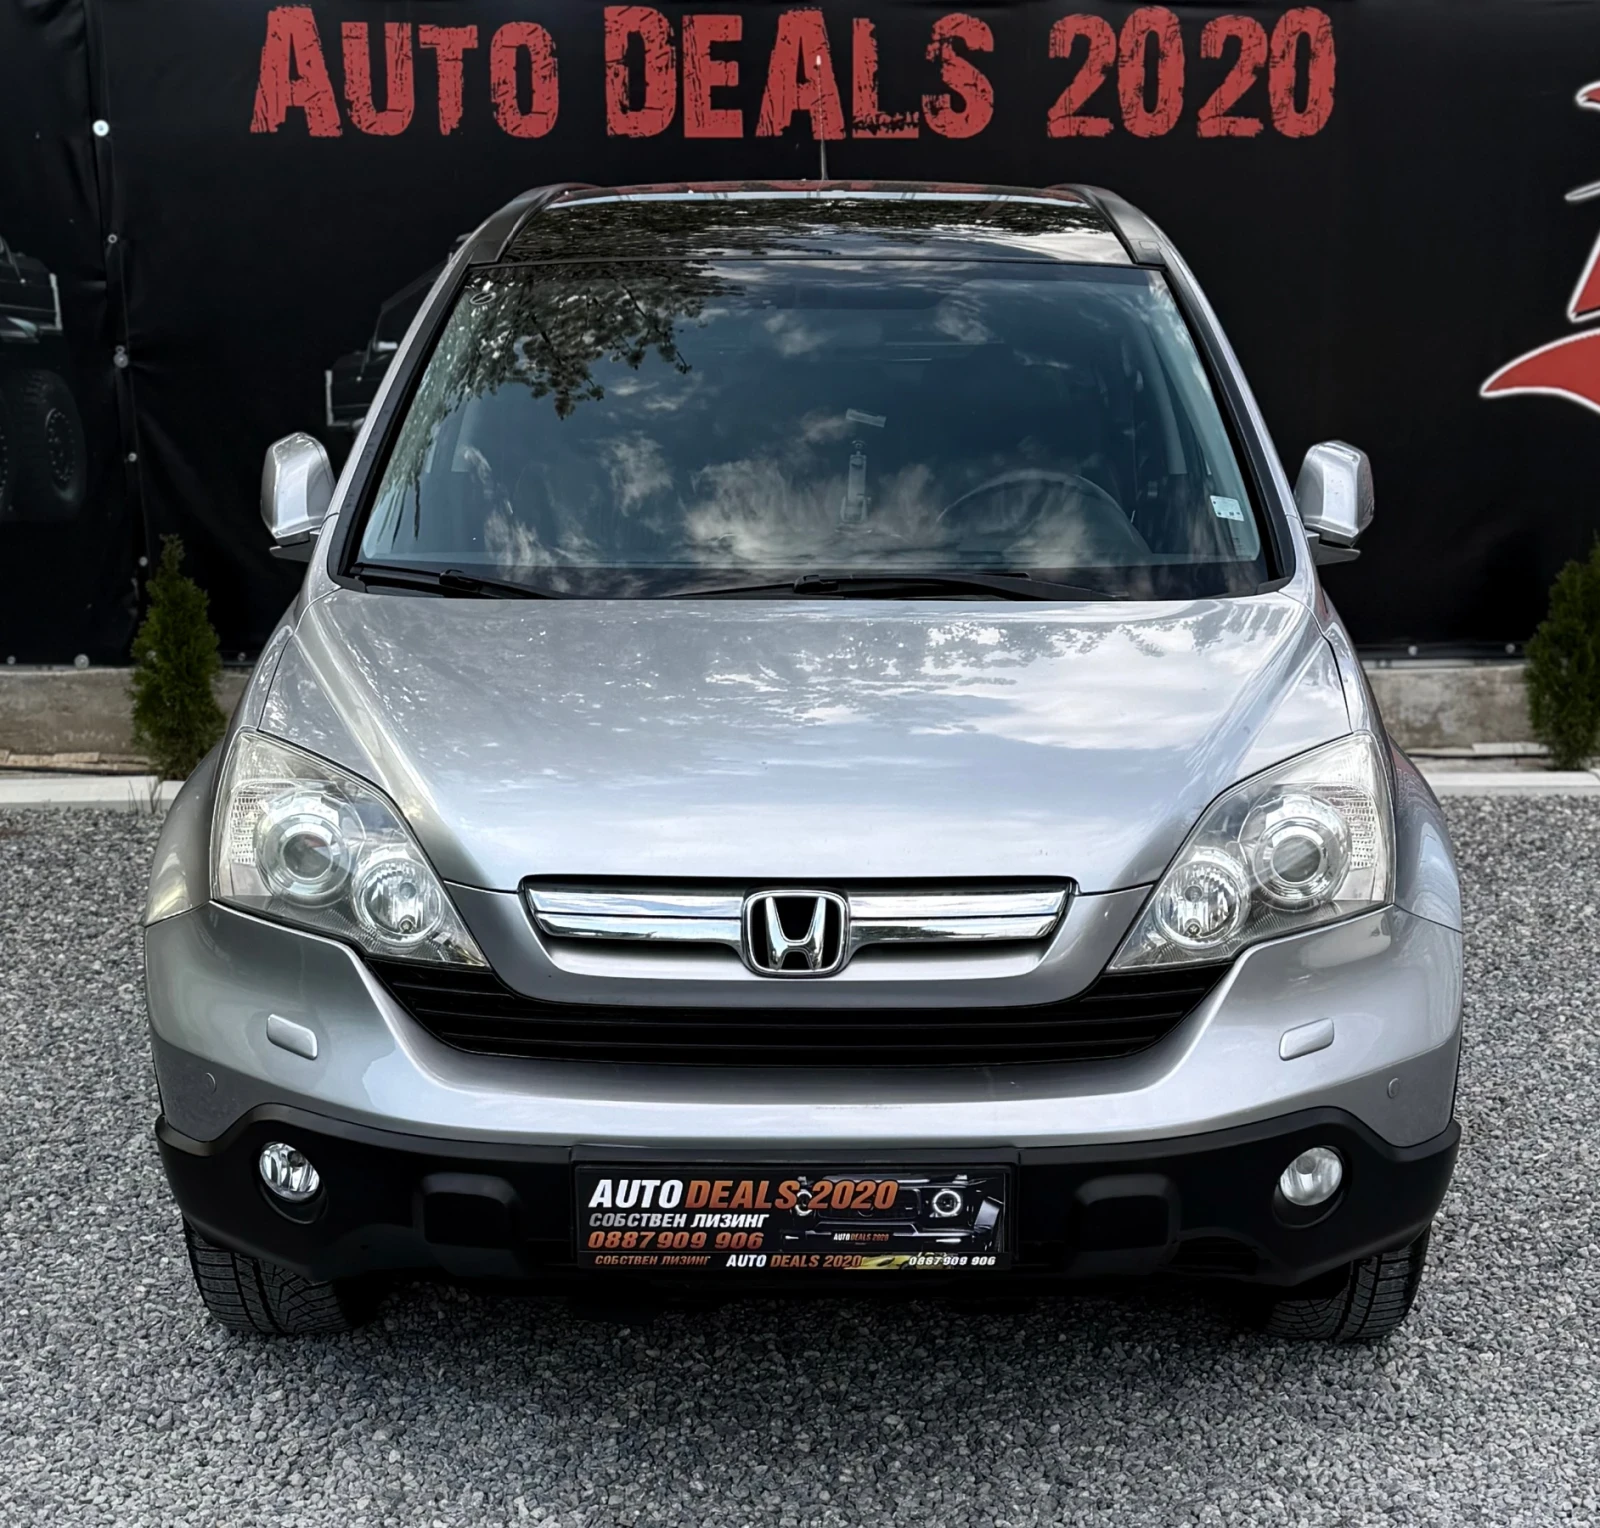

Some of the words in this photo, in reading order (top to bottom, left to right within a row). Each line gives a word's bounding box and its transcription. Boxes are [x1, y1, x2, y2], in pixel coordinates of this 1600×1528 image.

[250, 5, 560, 138] AUTO
[604, 5, 995, 140] DEALS
[1047, 6, 1336, 138] 2020
[588, 1179, 683, 1208] AUTO
[685, 1180, 800, 1209] DEALS
[808, 1180, 898, 1209] 2020
[589, 1213, 687, 1227] СОБСТВЕН
[690, 1214, 769, 1228] ЛИЗИНГ
[588, 1231, 656, 1249] 0887
[657, 1231, 707, 1249] 909
[715, 1232, 764, 1249] 906
[595, 1255, 658, 1265] СОБСТВЕН
[726, 1254, 767, 1268] AUTO
[770, 1255, 820, 1268] DEALS
[823, 1255, 862, 1268] 2020
[909, 1256, 942, 1266] 0887
[943, 1256, 968, 1266] 909
[971, 1256, 996, 1266] 906
